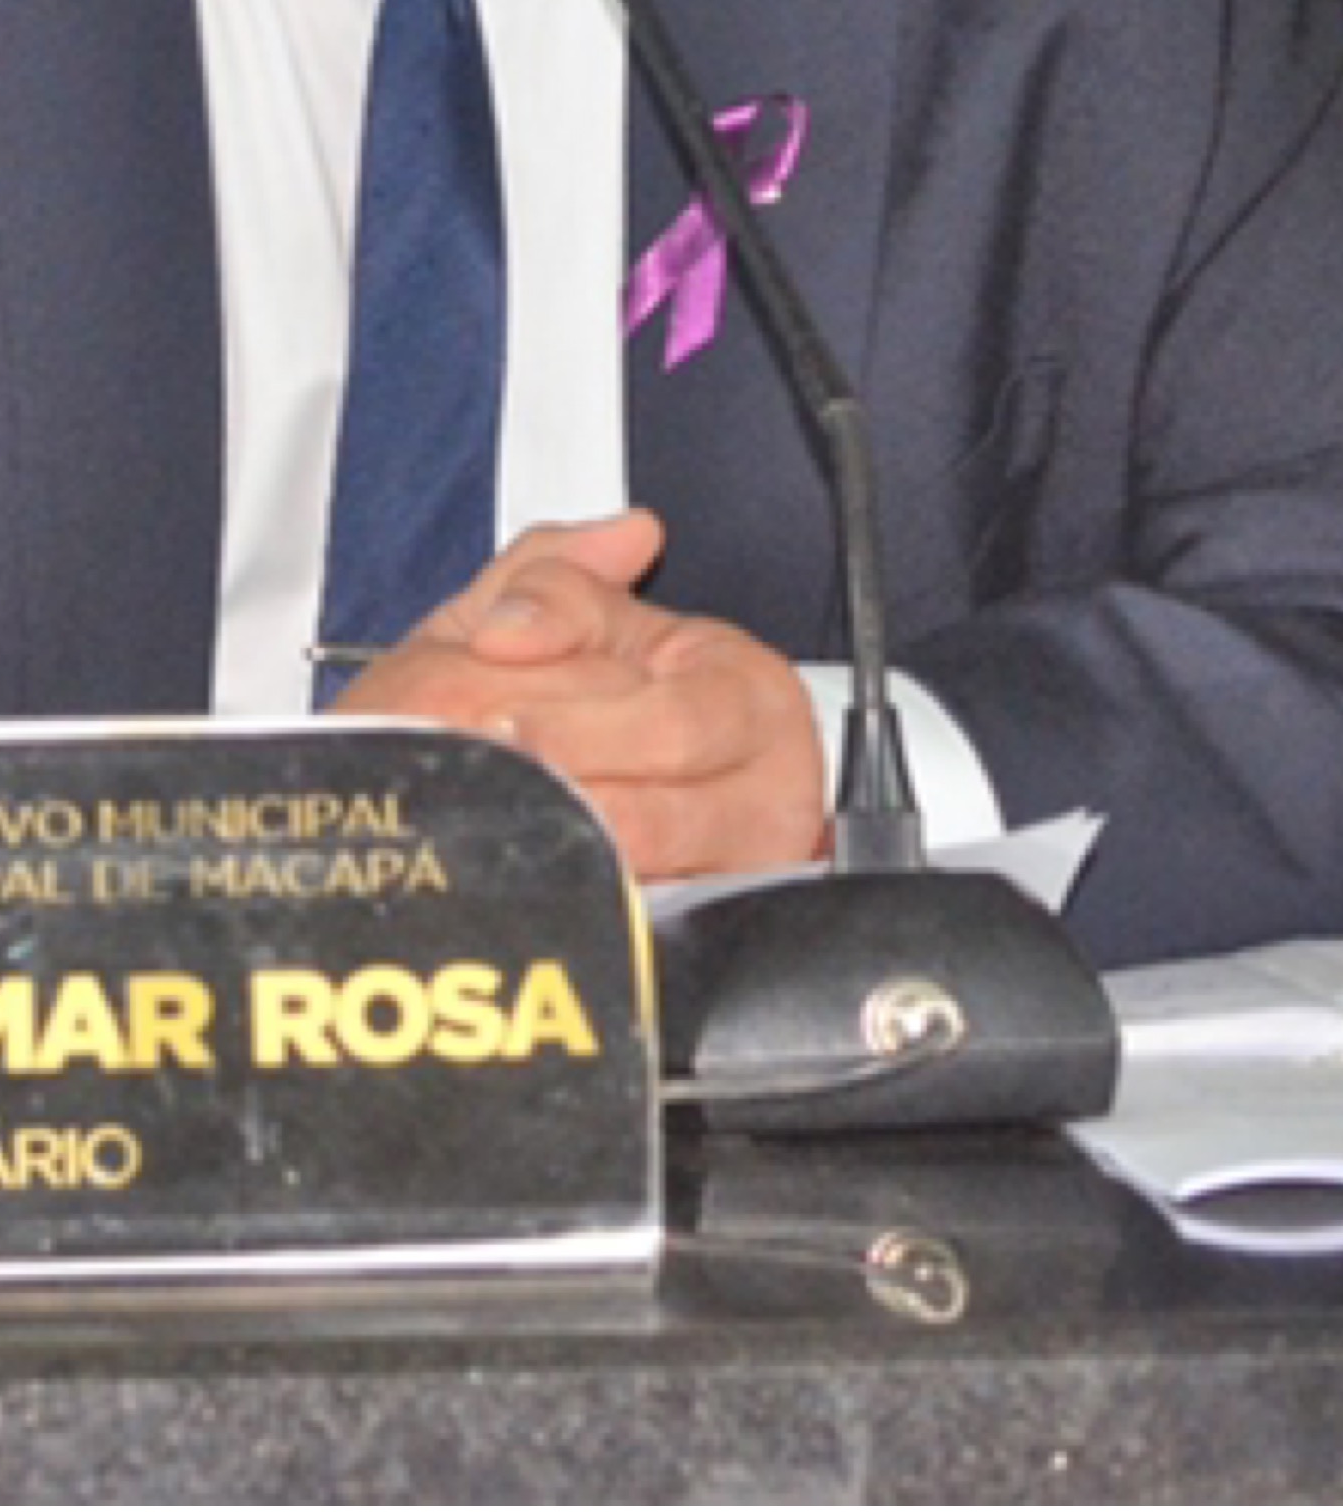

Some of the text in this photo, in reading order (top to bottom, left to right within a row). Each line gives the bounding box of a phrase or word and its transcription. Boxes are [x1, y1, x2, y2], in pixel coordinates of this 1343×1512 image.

[98, 792, 410, 845] MUNICIPAL
[189, 838, 451, 900] MACAPÁ
[249, 961, 603, 1070] ROSA
